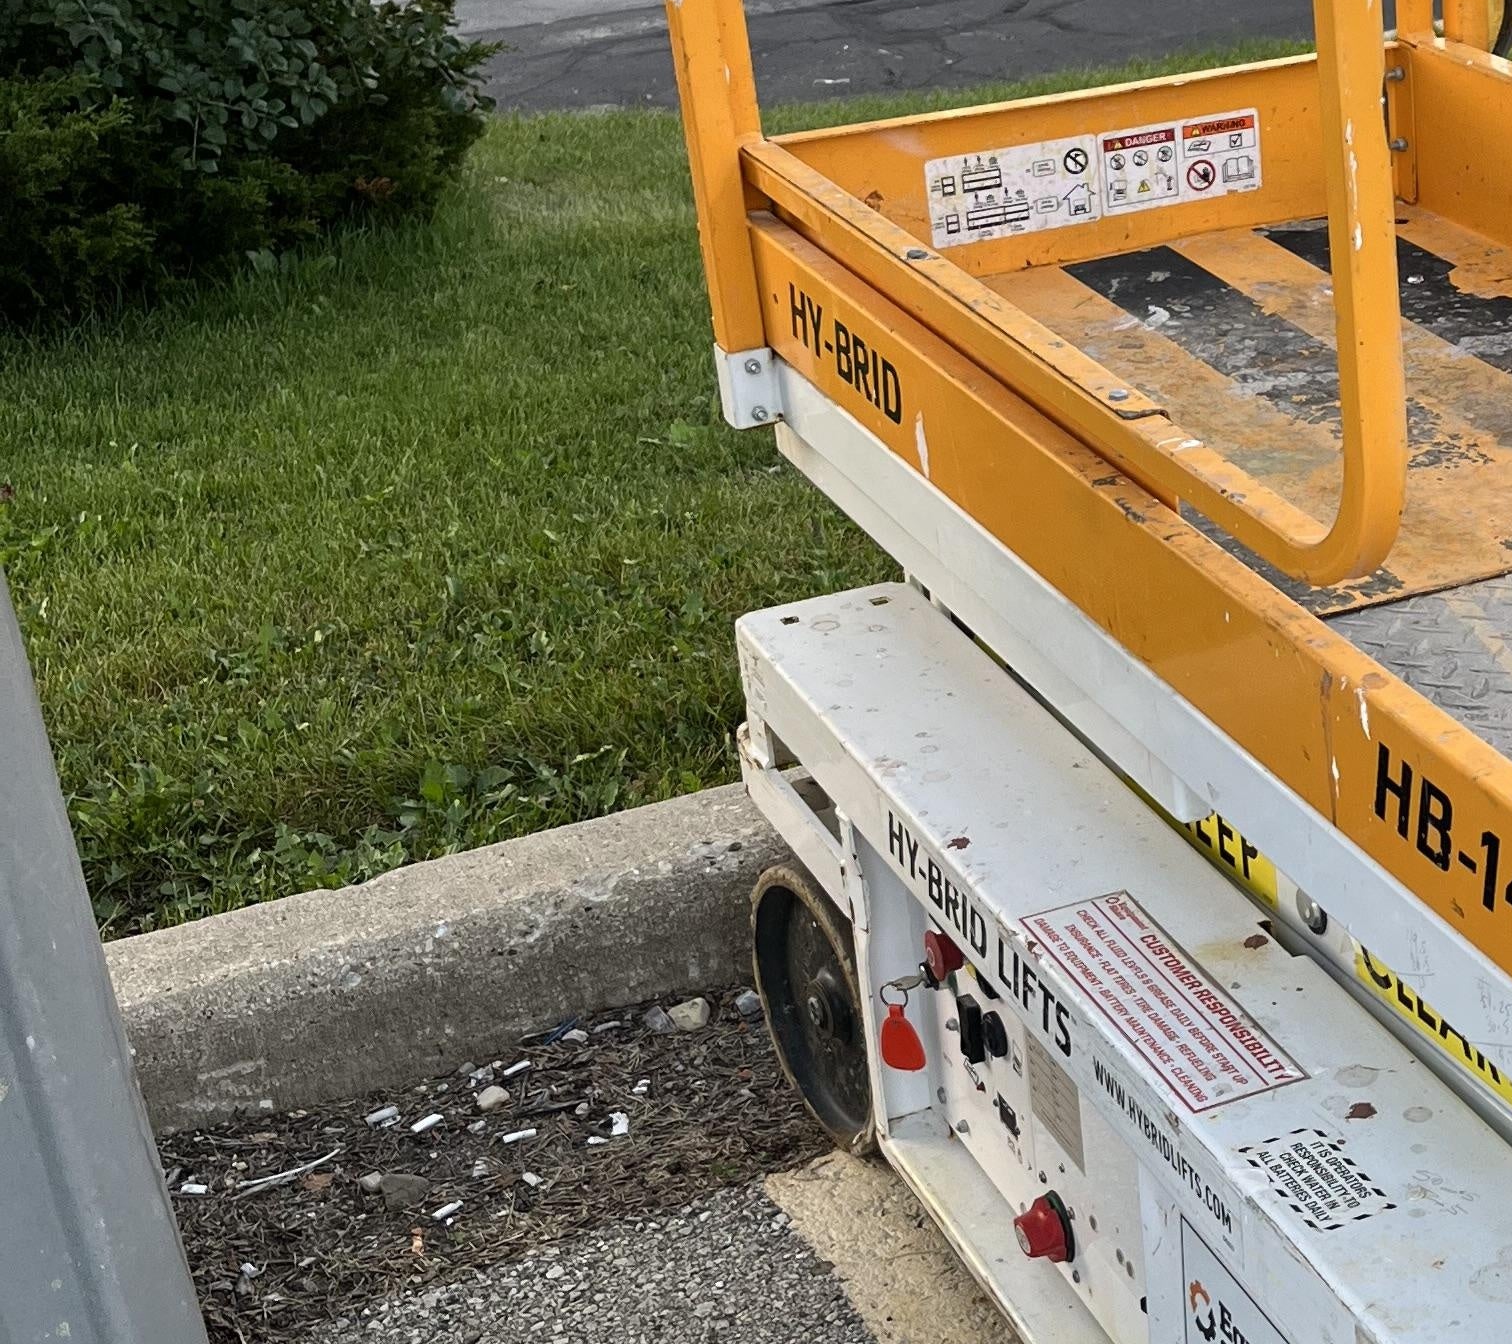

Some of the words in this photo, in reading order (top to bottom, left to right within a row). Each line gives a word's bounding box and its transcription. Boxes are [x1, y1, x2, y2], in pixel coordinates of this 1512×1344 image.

[1124, 132, 1167, 147] DANGER
[1201, 118, 1246, 134] WARNING
[789, 280, 902, 426] HY-BRID
[888, 810, 987, 959] HY-BRID
[998, 937, 1072, 1058] LIFTS
[1034, 918, 1063, 943] DAMAGE
[1064, 950, 1103, 986] EQUIPMENT
[1099, 989, 1130, 1017] BATTERY
[1125, 1016, 1175, 1065] MAINTENANCE
[1170, 1067, 1209, 1103] CLEANING
[1064, 924, 1103, 959] INSURANCE
[1099, 960, 1119, 979] FLAT
[1113, 974, 1136, 995] TIRES
[1133, 997, 1152, 1014] TIRE
[1148, 1012, 1179, 1042] DAMAGE
[1177, 1043, 1217, 1082] REFUELING
[1076, 909, 1098, 932] CHECK
[1095, 927, 1109, 941] ALL
[1104, 939, 1128, 959] FLUID
[1121, 957, 1149, 982] LEVELS
[1146, 983, 1177, 1010] GREASE
[1170, 1006, 1195, 1028] DAILY
[1187, 1027, 1219, 1056] BEFORE
[1212, 1051, 1238, 1076] START
[1232, 1073, 1249, 1085] UP
[1140, 934, 1204, 990] CUSTOMER
[1192, 984, 1293, 1080] RESPONSIBILITY
[1092, 1055, 1232, 1234] WWW.HYBRIDLIFTS.COM
[1290, 1142, 1352, 1198] RESPONSIBILITY
[1344, 1196, 1361, 1209] TO
[1310, 1141, 1325, 1150] IT
[1317, 1148, 1333, 1159] IS
[1325, 1156, 1372, 1199] OPERATORS
[1256, 1151, 1273, 1166] ALL
[1270, 1163, 1312, 1202] BATTERIES
[1304, 1200, 1333, 1222] DAILY
[1279, 1152, 1309, 1177] CHECK
[1302, 1174, 1332, 1202] WATER
[1325, 1199, 1341, 1210] IN
